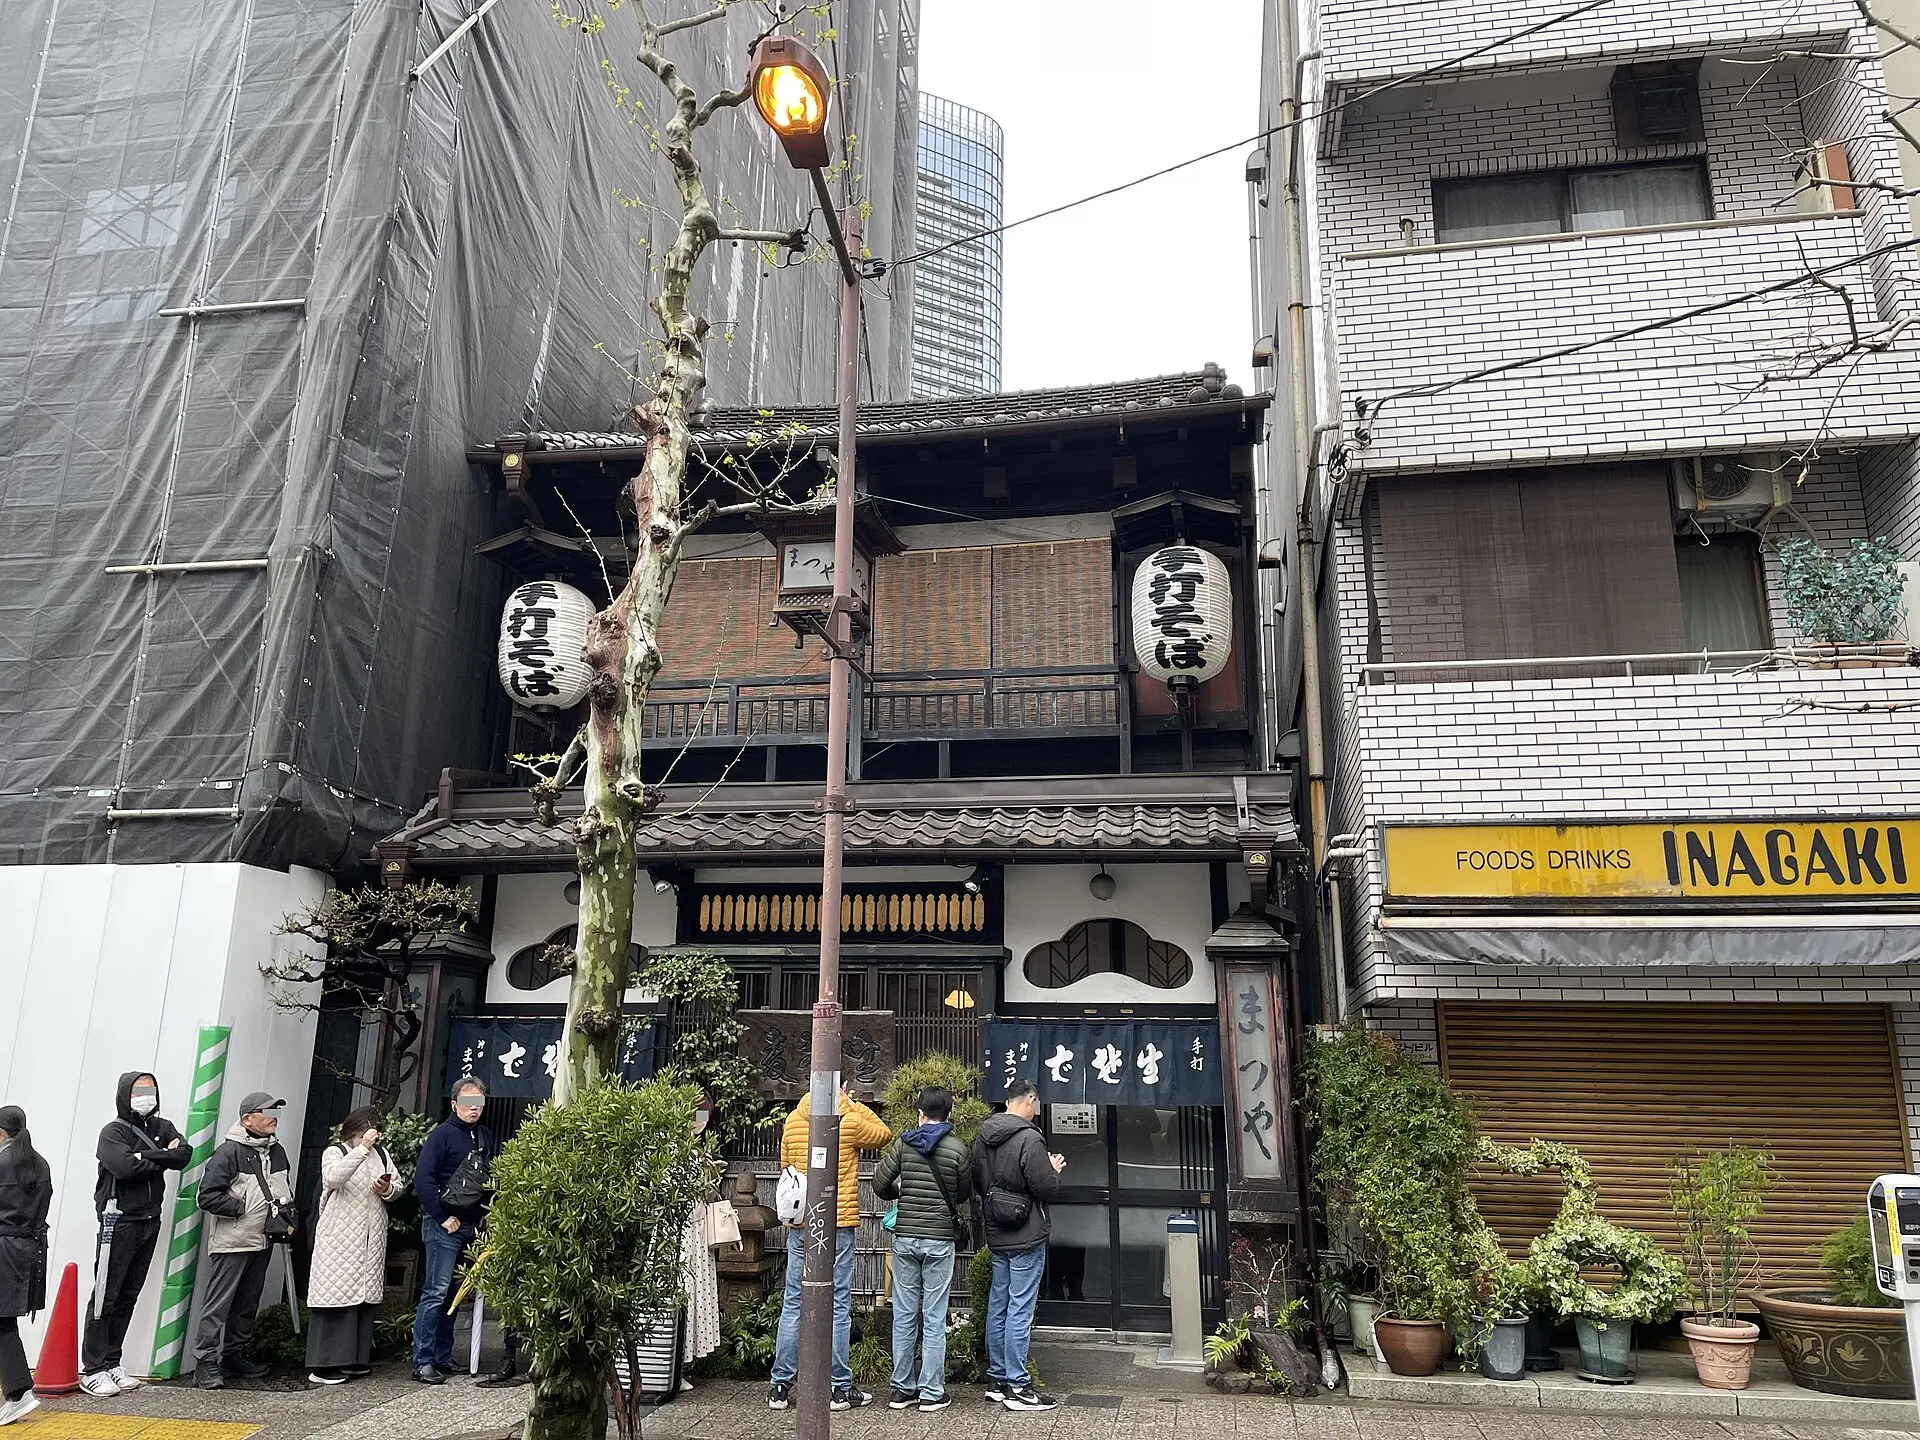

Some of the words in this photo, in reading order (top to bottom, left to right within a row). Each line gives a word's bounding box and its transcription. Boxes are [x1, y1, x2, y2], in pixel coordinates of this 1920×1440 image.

[789, 547, 835, 584] まつや
[1149, 548, 1213, 669] 手打そば
[507, 583, 564, 698] 手打そば
[1456, 850, 1535, 870] FOODS
[1548, 849, 1631, 869] DRINKS
[1662, 827, 1908, 887] INAGAKI
[1189, 1036, 1204, 1072] 手打
[1238, 985, 1274, 1160] まつや
